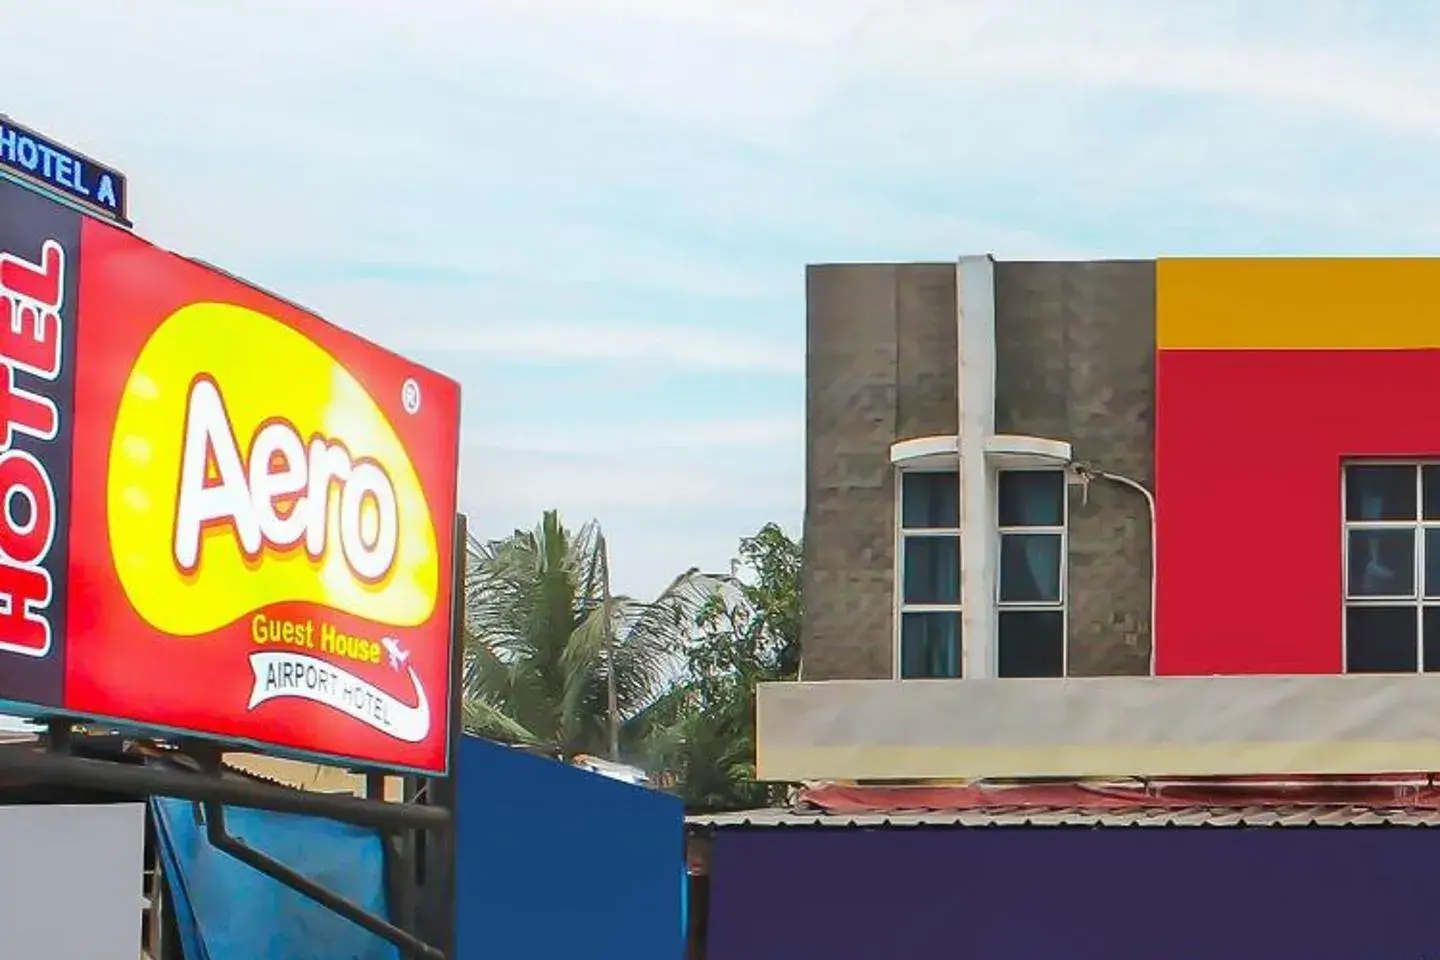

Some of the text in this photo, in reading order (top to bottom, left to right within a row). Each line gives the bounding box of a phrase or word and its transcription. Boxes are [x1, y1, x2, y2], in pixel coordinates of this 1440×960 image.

[0, 126, 117, 208] HOTEL A
[0, 238, 66, 657] HOTEL
[173, 372, 399, 585] Aero
[252, 613, 381, 664] Guest House
[265, 661, 393, 726] AIRPORT HOTEL
